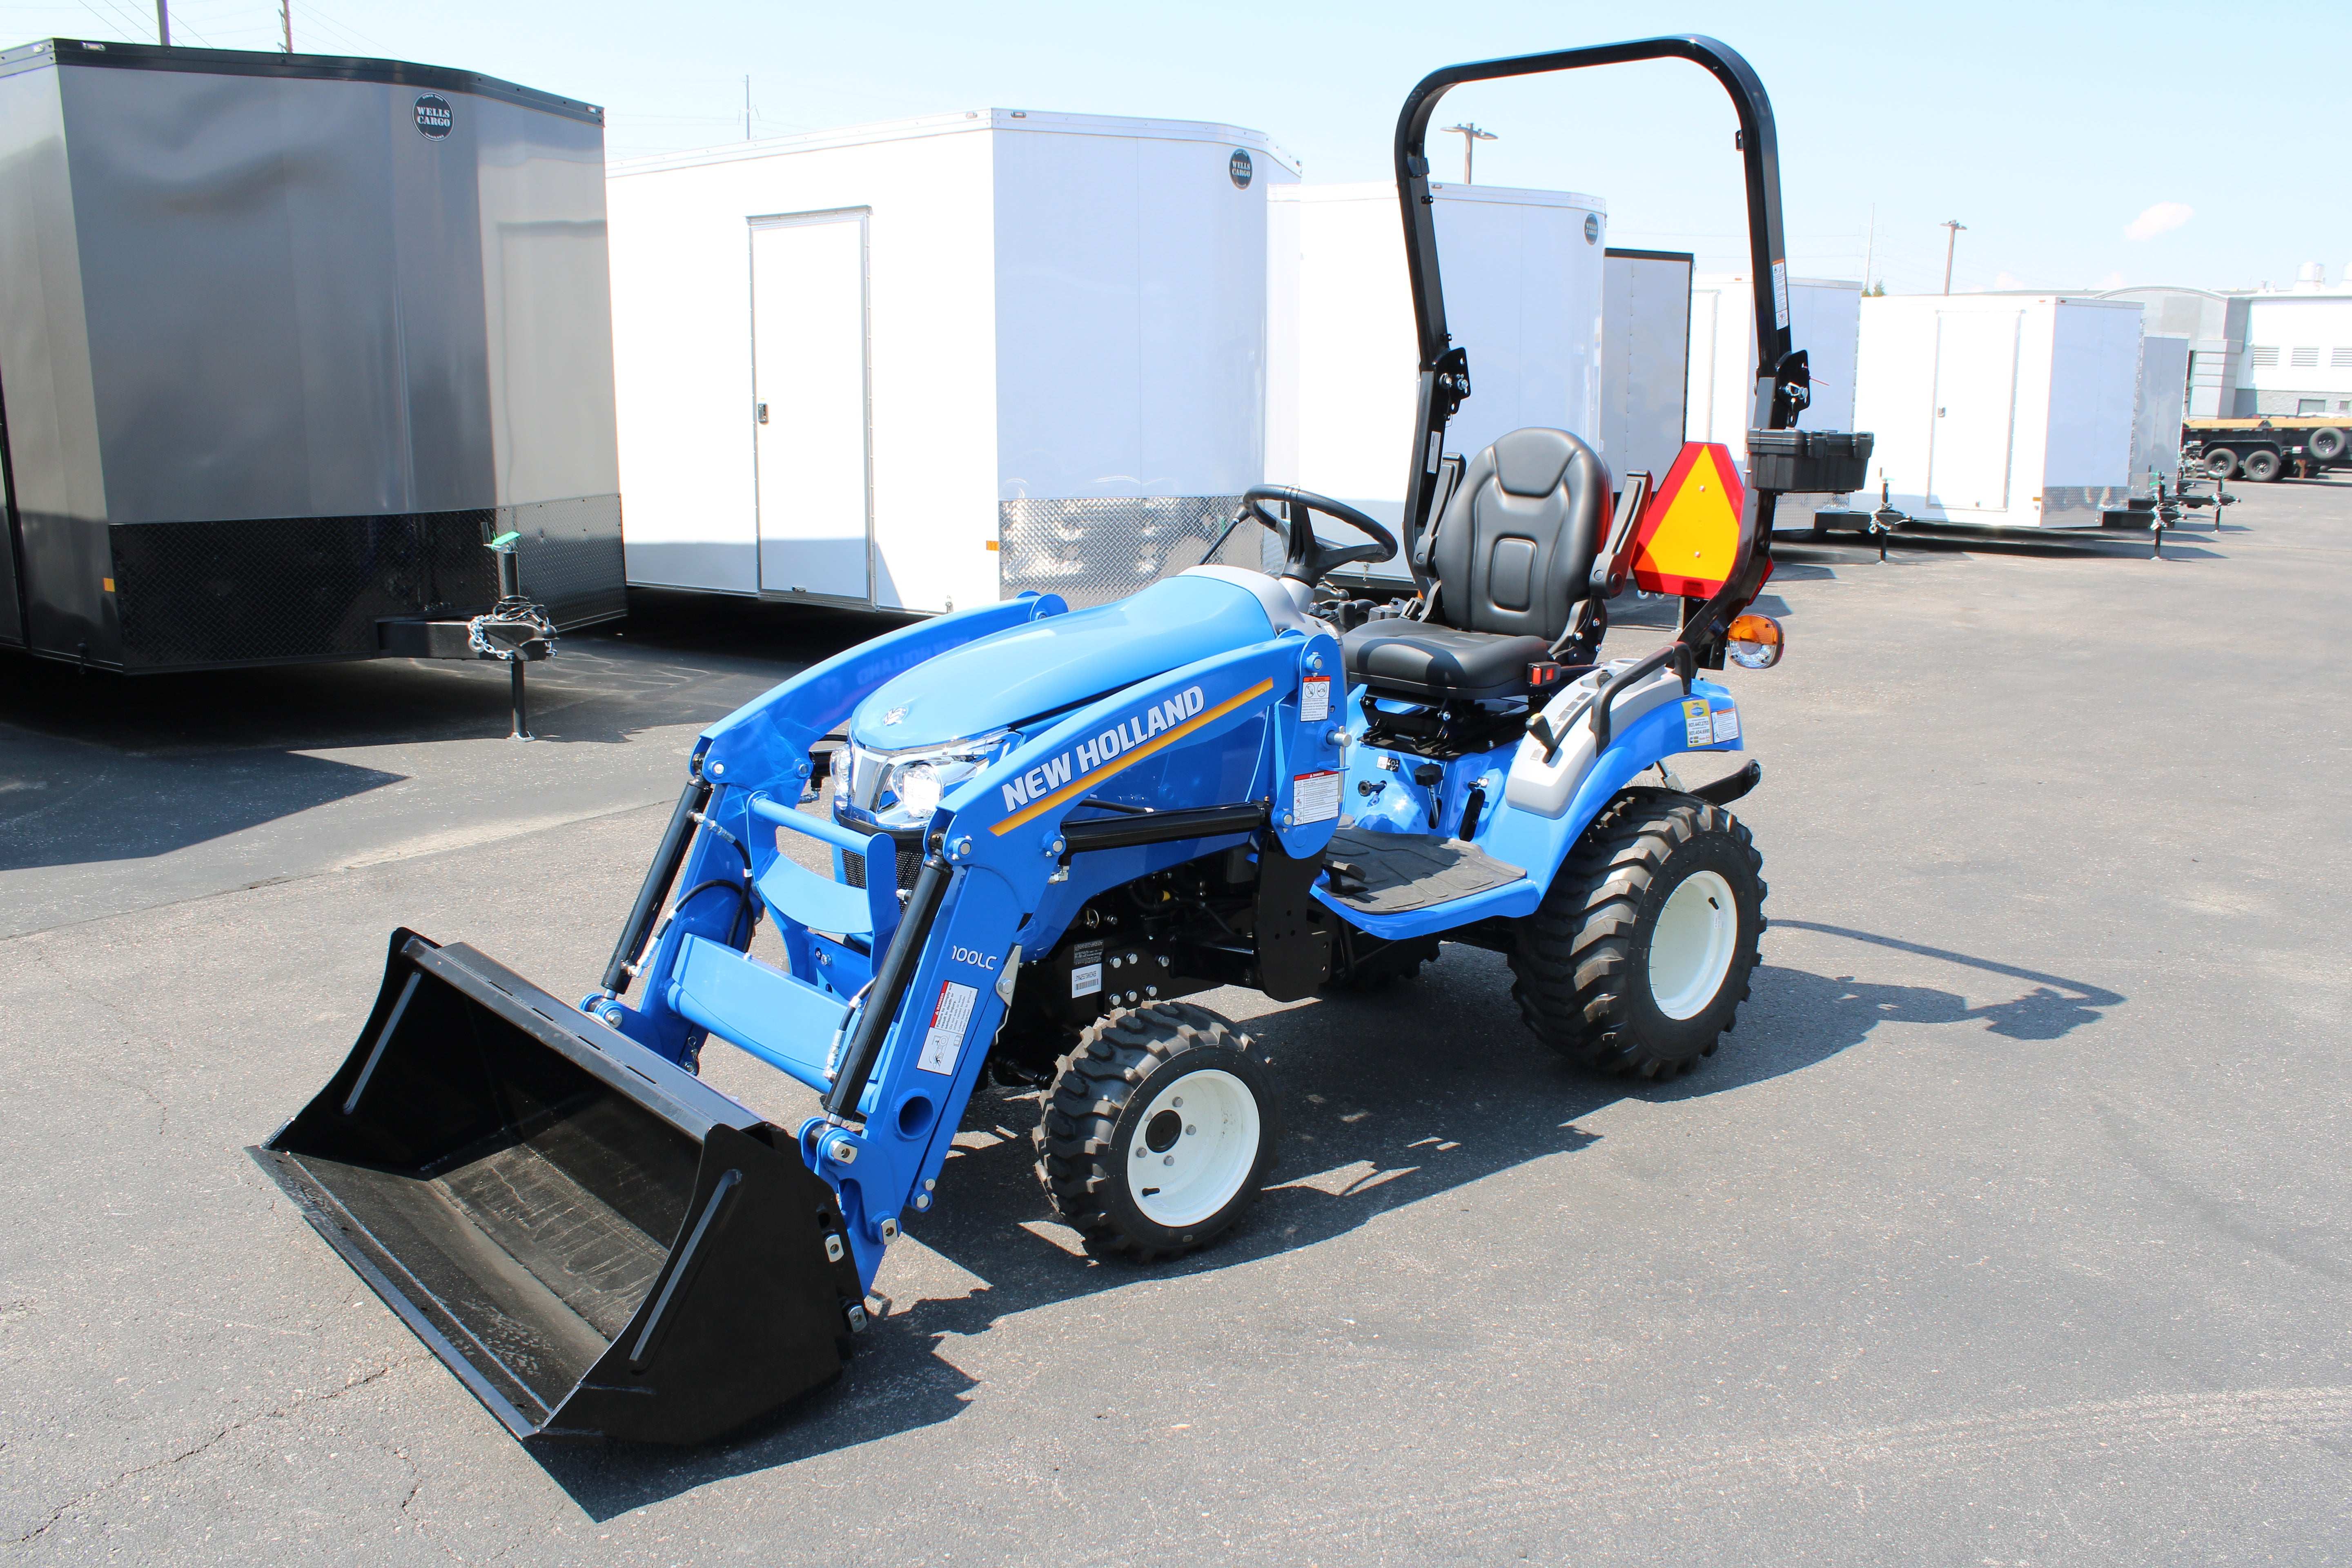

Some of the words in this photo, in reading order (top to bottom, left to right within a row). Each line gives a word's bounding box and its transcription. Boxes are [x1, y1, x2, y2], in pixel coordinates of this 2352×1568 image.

[416, 106, 450, 118] WELLS
[416, 116, 451, 127] CARGO
[1232, 160, 1250, 170] WELLS
[1232, 168, 1250, 178] CARGO
[1002, 752, 1072, 812] NEW
[1076, 686, 1205, 773] HOLLAND
[951, 944, 998, 971] 100LC
[936, 993, 944, 1009] DANGER
[942, 992, 951, 1006] comply
